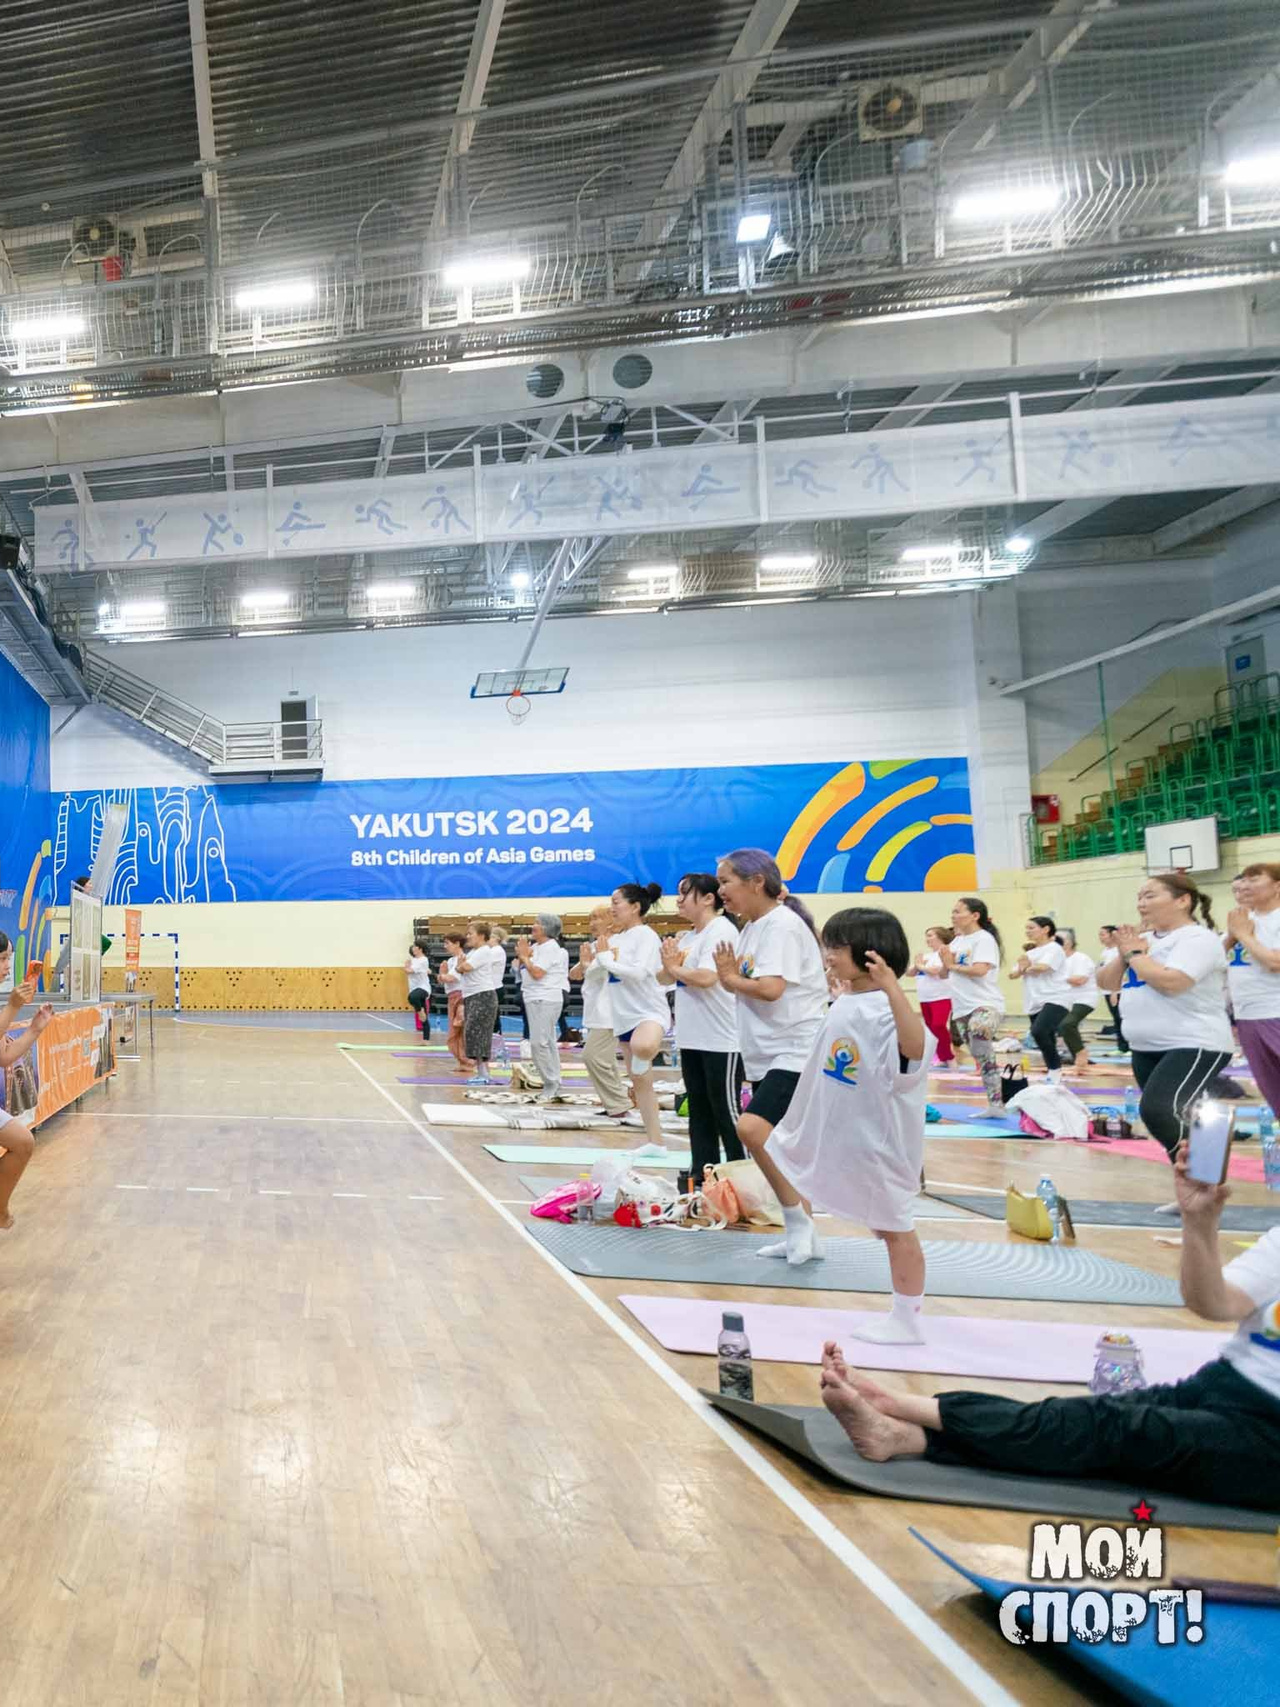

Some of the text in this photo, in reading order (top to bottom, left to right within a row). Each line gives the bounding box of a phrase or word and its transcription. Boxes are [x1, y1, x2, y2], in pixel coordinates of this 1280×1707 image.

[349, 807, 594, 838] YAKUTSK 2024
[351, 846, 595, 866] 8th Children of Asia Games
